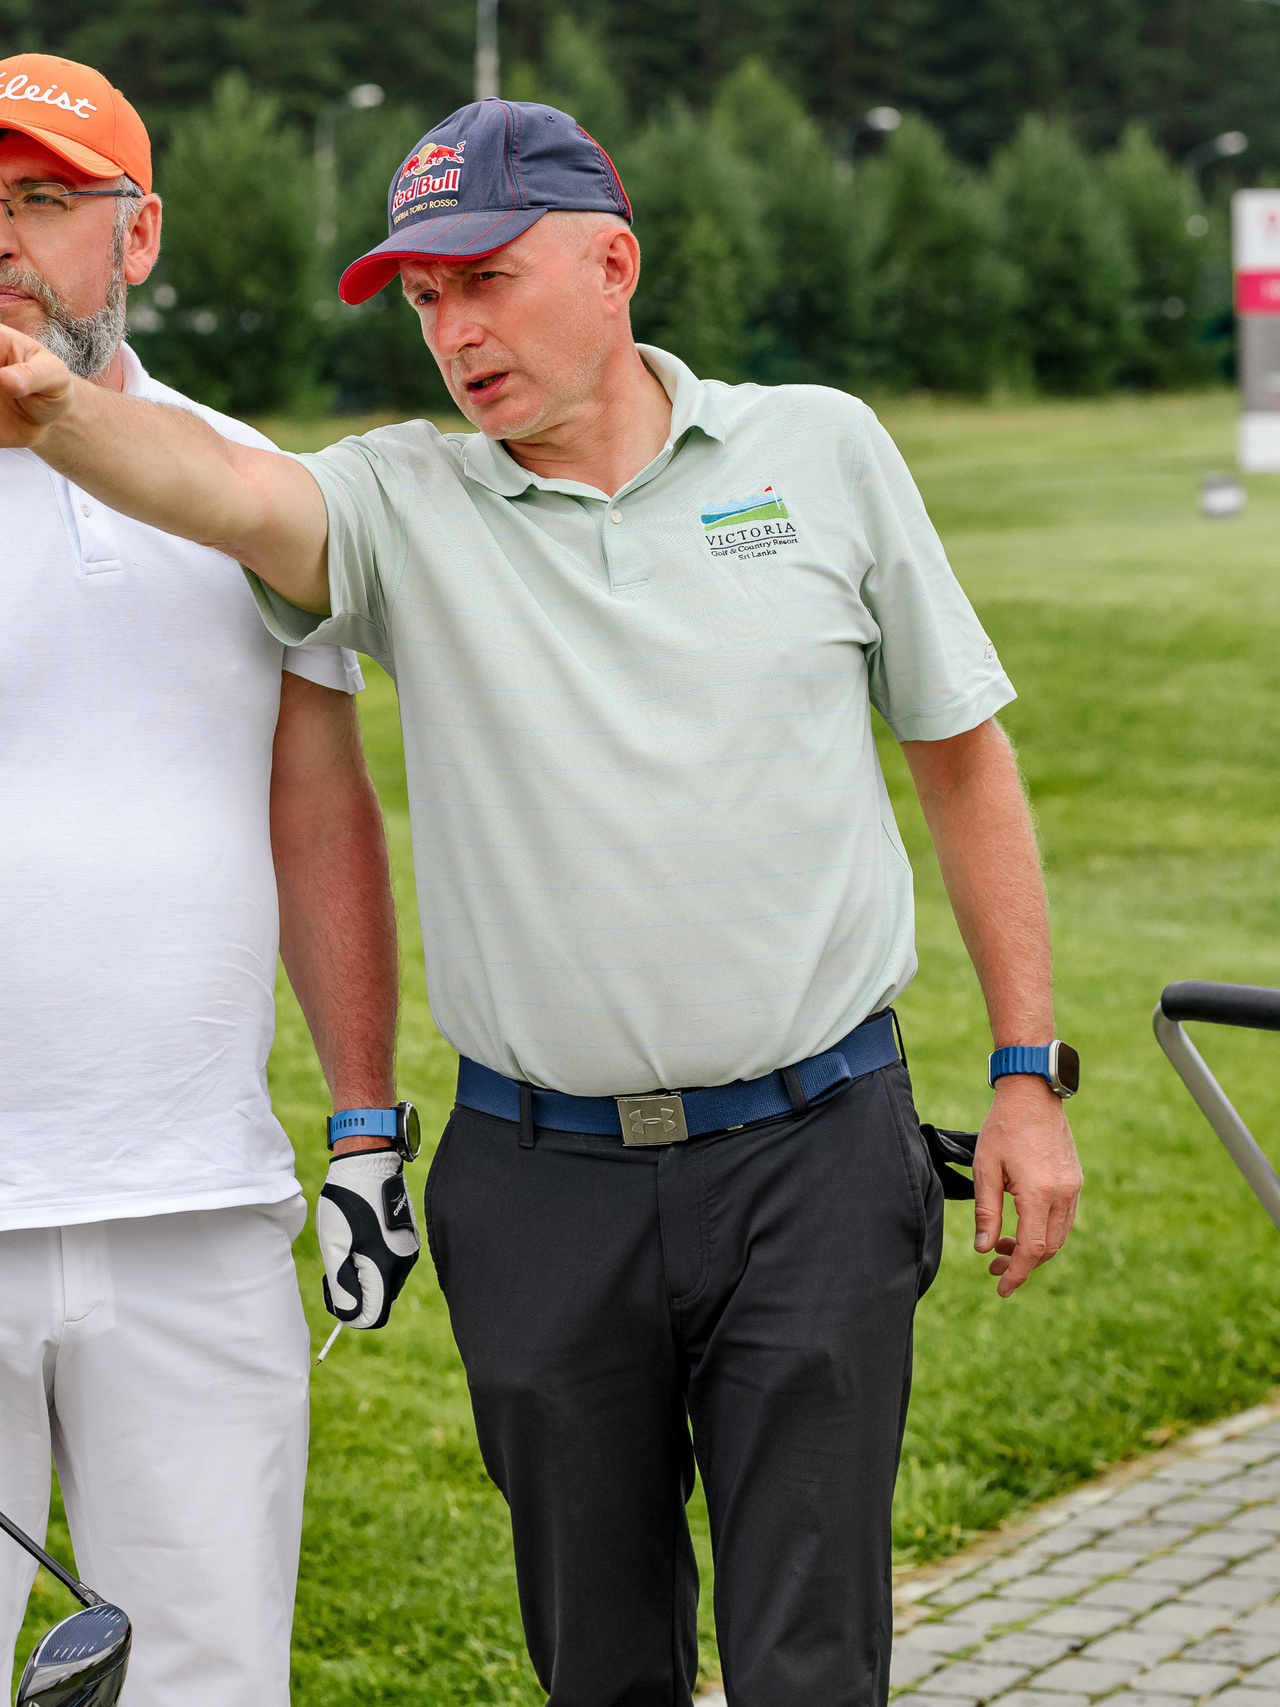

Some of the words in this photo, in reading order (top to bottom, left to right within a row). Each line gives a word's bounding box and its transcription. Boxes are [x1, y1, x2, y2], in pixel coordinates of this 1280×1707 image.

[417, 168, 460, 197] Bull
[409, 202, 428, 215] TORO
[429, 198, 459, 209] ROSSO
[705, 522, 796, 546] VICTORIA
[711, 549, 728, 557] Golf
[737, 541, 772, 553] Country
[772, 538, 799, 546] Resort
[738, 553, 751, 561] Sri
[751, 549, 777, 558] Lanka
